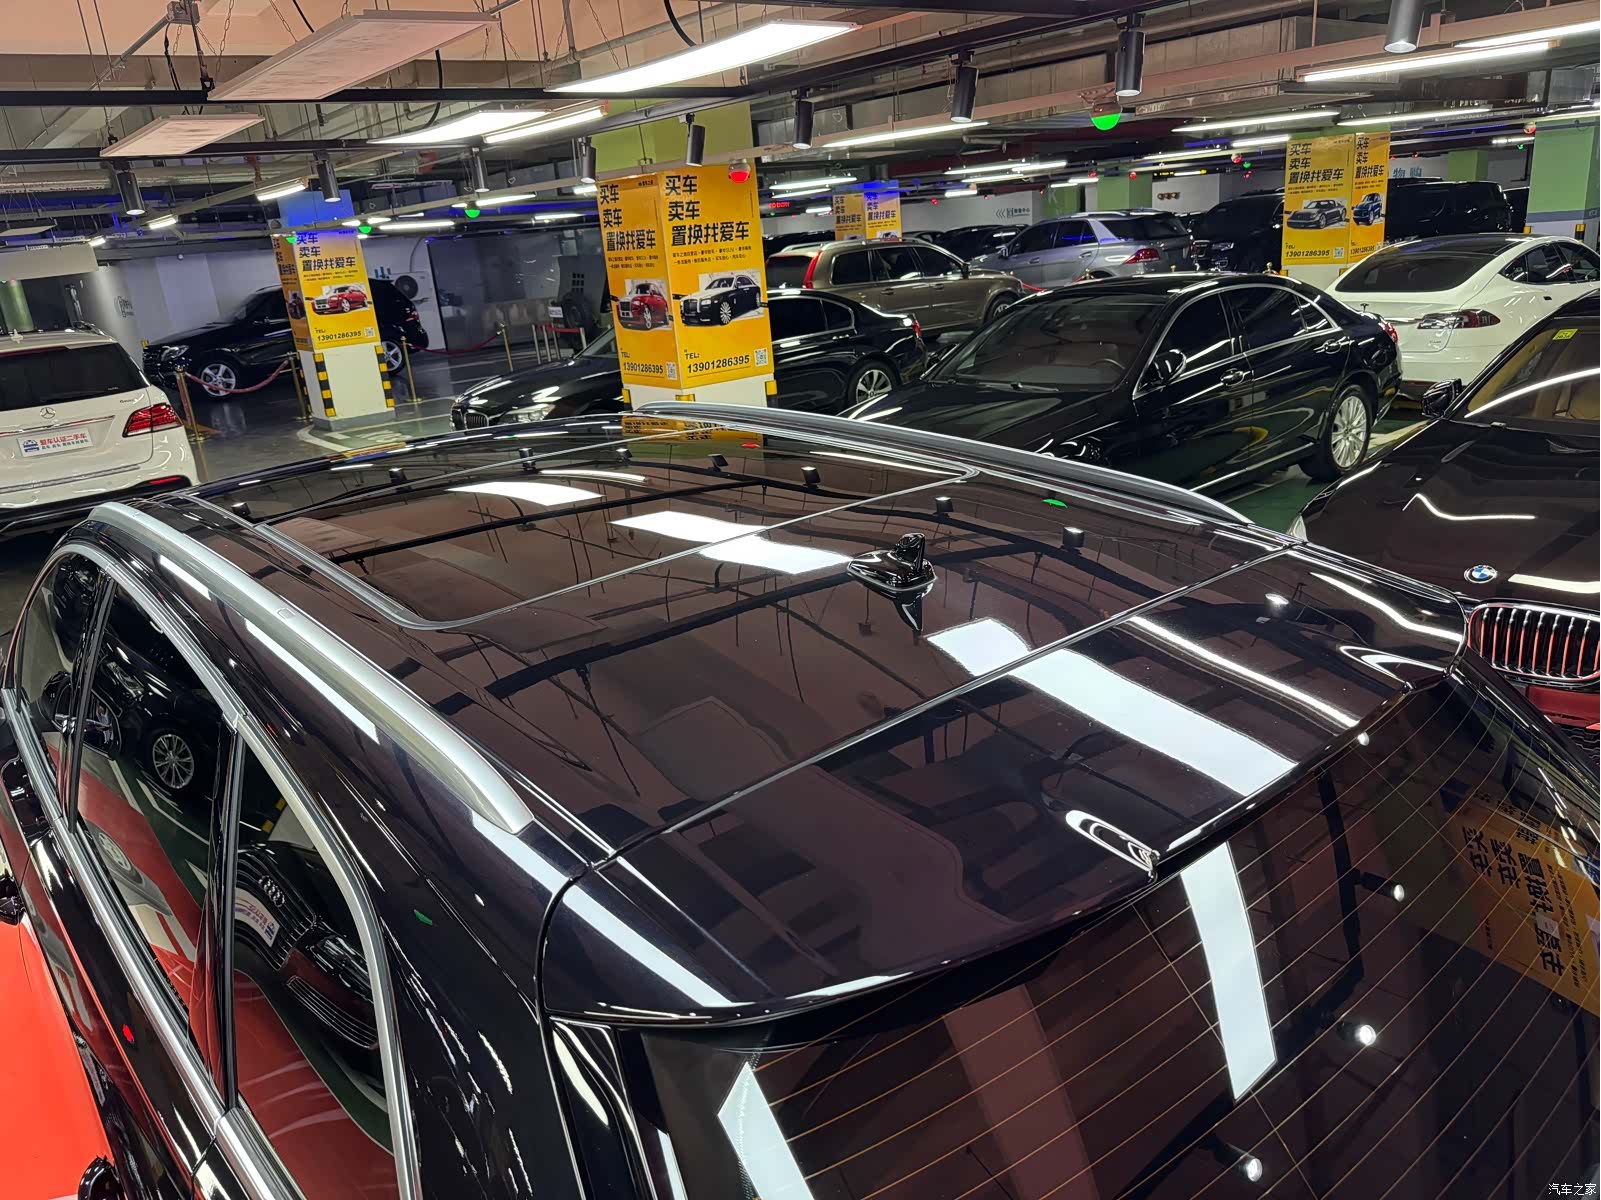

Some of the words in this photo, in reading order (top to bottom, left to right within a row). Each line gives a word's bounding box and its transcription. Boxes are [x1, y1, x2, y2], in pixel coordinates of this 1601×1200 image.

[1289, 143, 1312, 156] 买车
[1289, 157, 1312, 170] 卖车
[1288, 168, 1344, 184] 置换找爱车
[665, 174, 698, 196] 买车
[600, 183, 619, 205] 买车
[603, 208, 622, 228] 卖车
[668, 200, 701, 221] 卖车
[296, 232, 319, 245] 买车
[607, 229, 656, 252] 置换找爱车
[671, 221, 749, 247] 置换找爱车
[299, 246, 320, 258] 卖车
[302, 257, 356, 271] 置换找爱车
[317, 331, 362, 341] 13901286395
[623, 362, 664, 374] 13901286395
[687, 355, 750, 373] 13901286395
